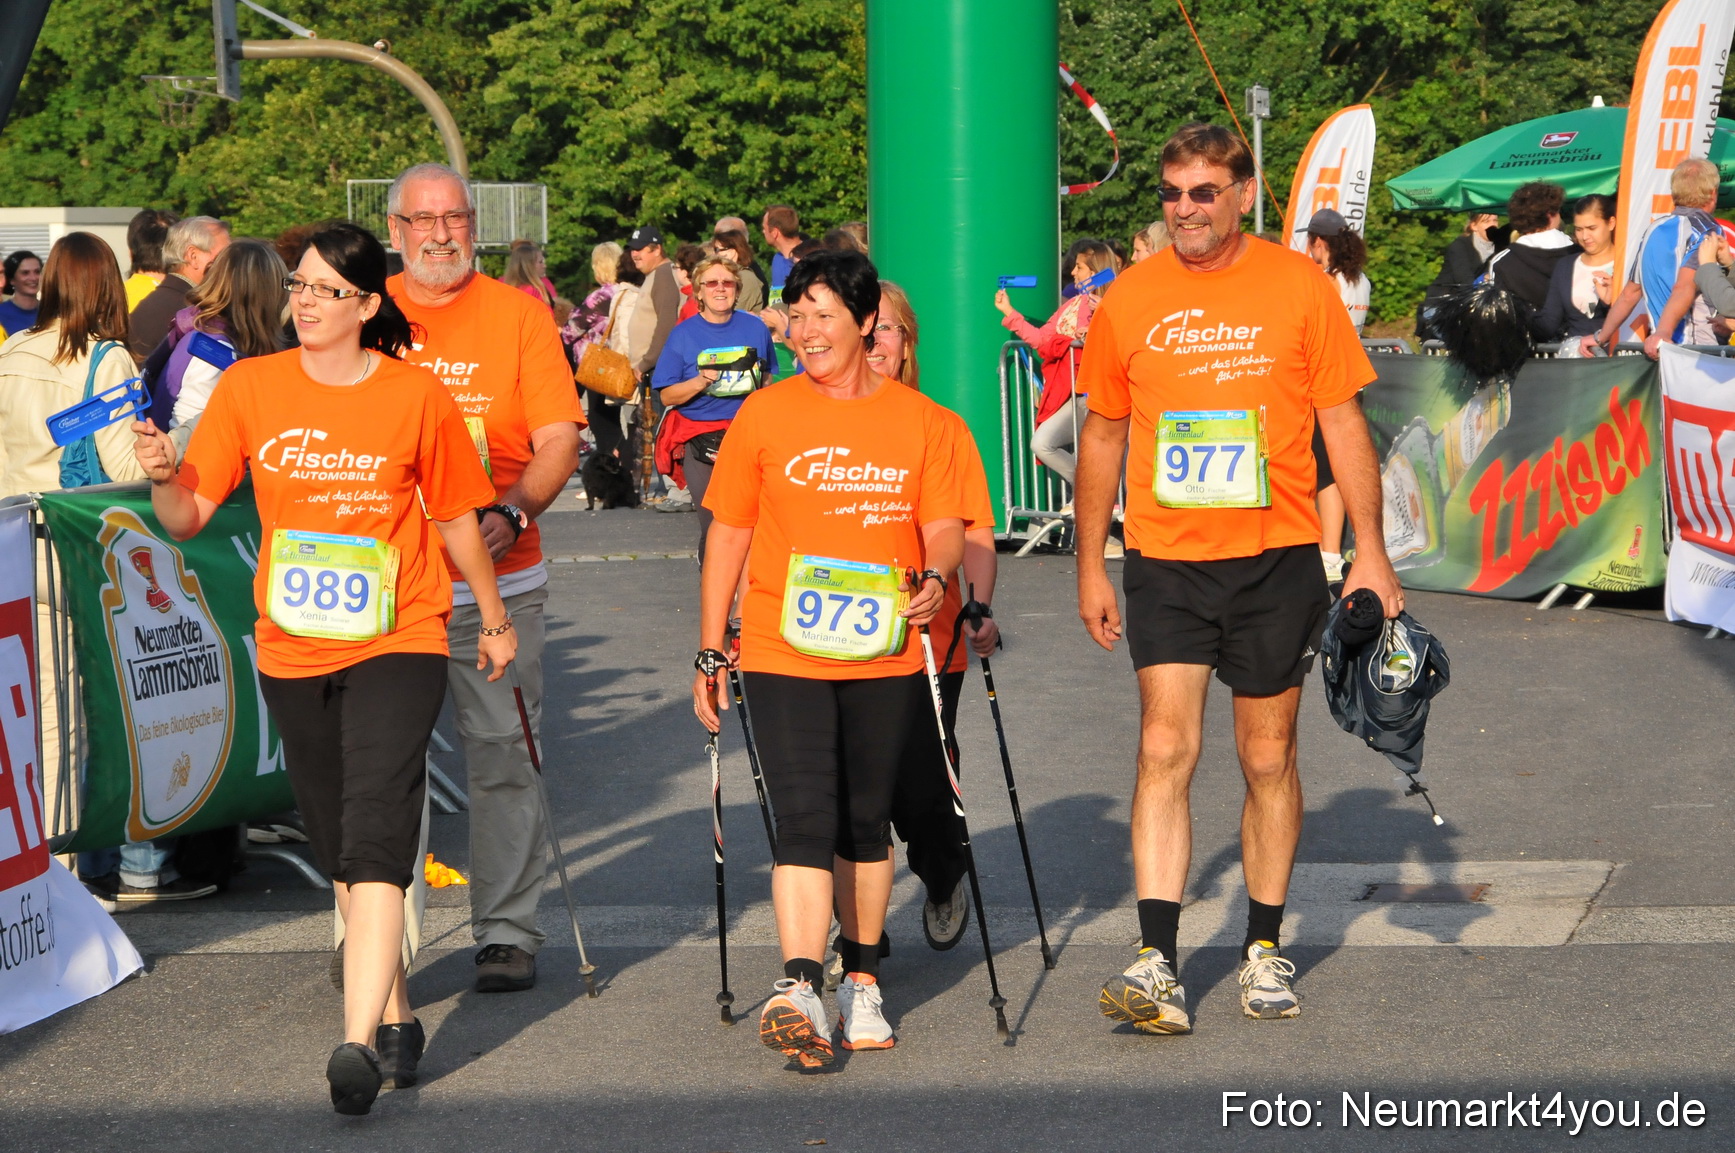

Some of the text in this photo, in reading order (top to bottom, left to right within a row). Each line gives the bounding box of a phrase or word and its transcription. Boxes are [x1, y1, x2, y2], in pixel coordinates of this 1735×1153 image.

[1488, 152, 1603, 170] Lammsbräu
[1509, 148, 1592, 160] Neumarkter
[1165, 322, 1262, 346] Fischer
[1173, 342, 1254, 355] AUTOMOBILE
[1188, 362, 1208, 375] und
[1210, 359, 1230, 370] das
[1232, 354, 1276, 367] Lächeln
[440, 378, 471, 386] BILE
[1215, 366, 1272, 385] fährt mit!
[452, 392, 494, 402] ächeln
[1168, 430, 1204, 438] firmenlauf
[280, 446, 387, 470] Fischer
[1166, 445, 1246, 482] 977
[289, 470, 377, 481] AUTOMOBILE
[807, 462, 909, 482] Fischer
[817, 482, 902, 493] AUTOMOBILE
[1186, 485, 1205, 493] Otto
[308, 492, 330, 504] und
[332, 490, 352, 501] das
[354, 490, 394, 501] Lächeln
[336, 503, 392, 518] fährt mit!
[835, 502, 857, 514] und
[859, 500, 880, 512] das
[862, 513, 892, 528] fährt
[289, 552, 331, 562] firmenlauf
[804, 574, 844, 587] firmenlauf
[283, 567, 369, 614] 989
[299, 610, 327, 622] Xenia
[796, 590, 880, 636] 973
[801, 630, 848, 644] Marianne
[127, 644, 221, 702] Lammsbräu
[139, 706, 224, 742] Das feine ökologische Bier
